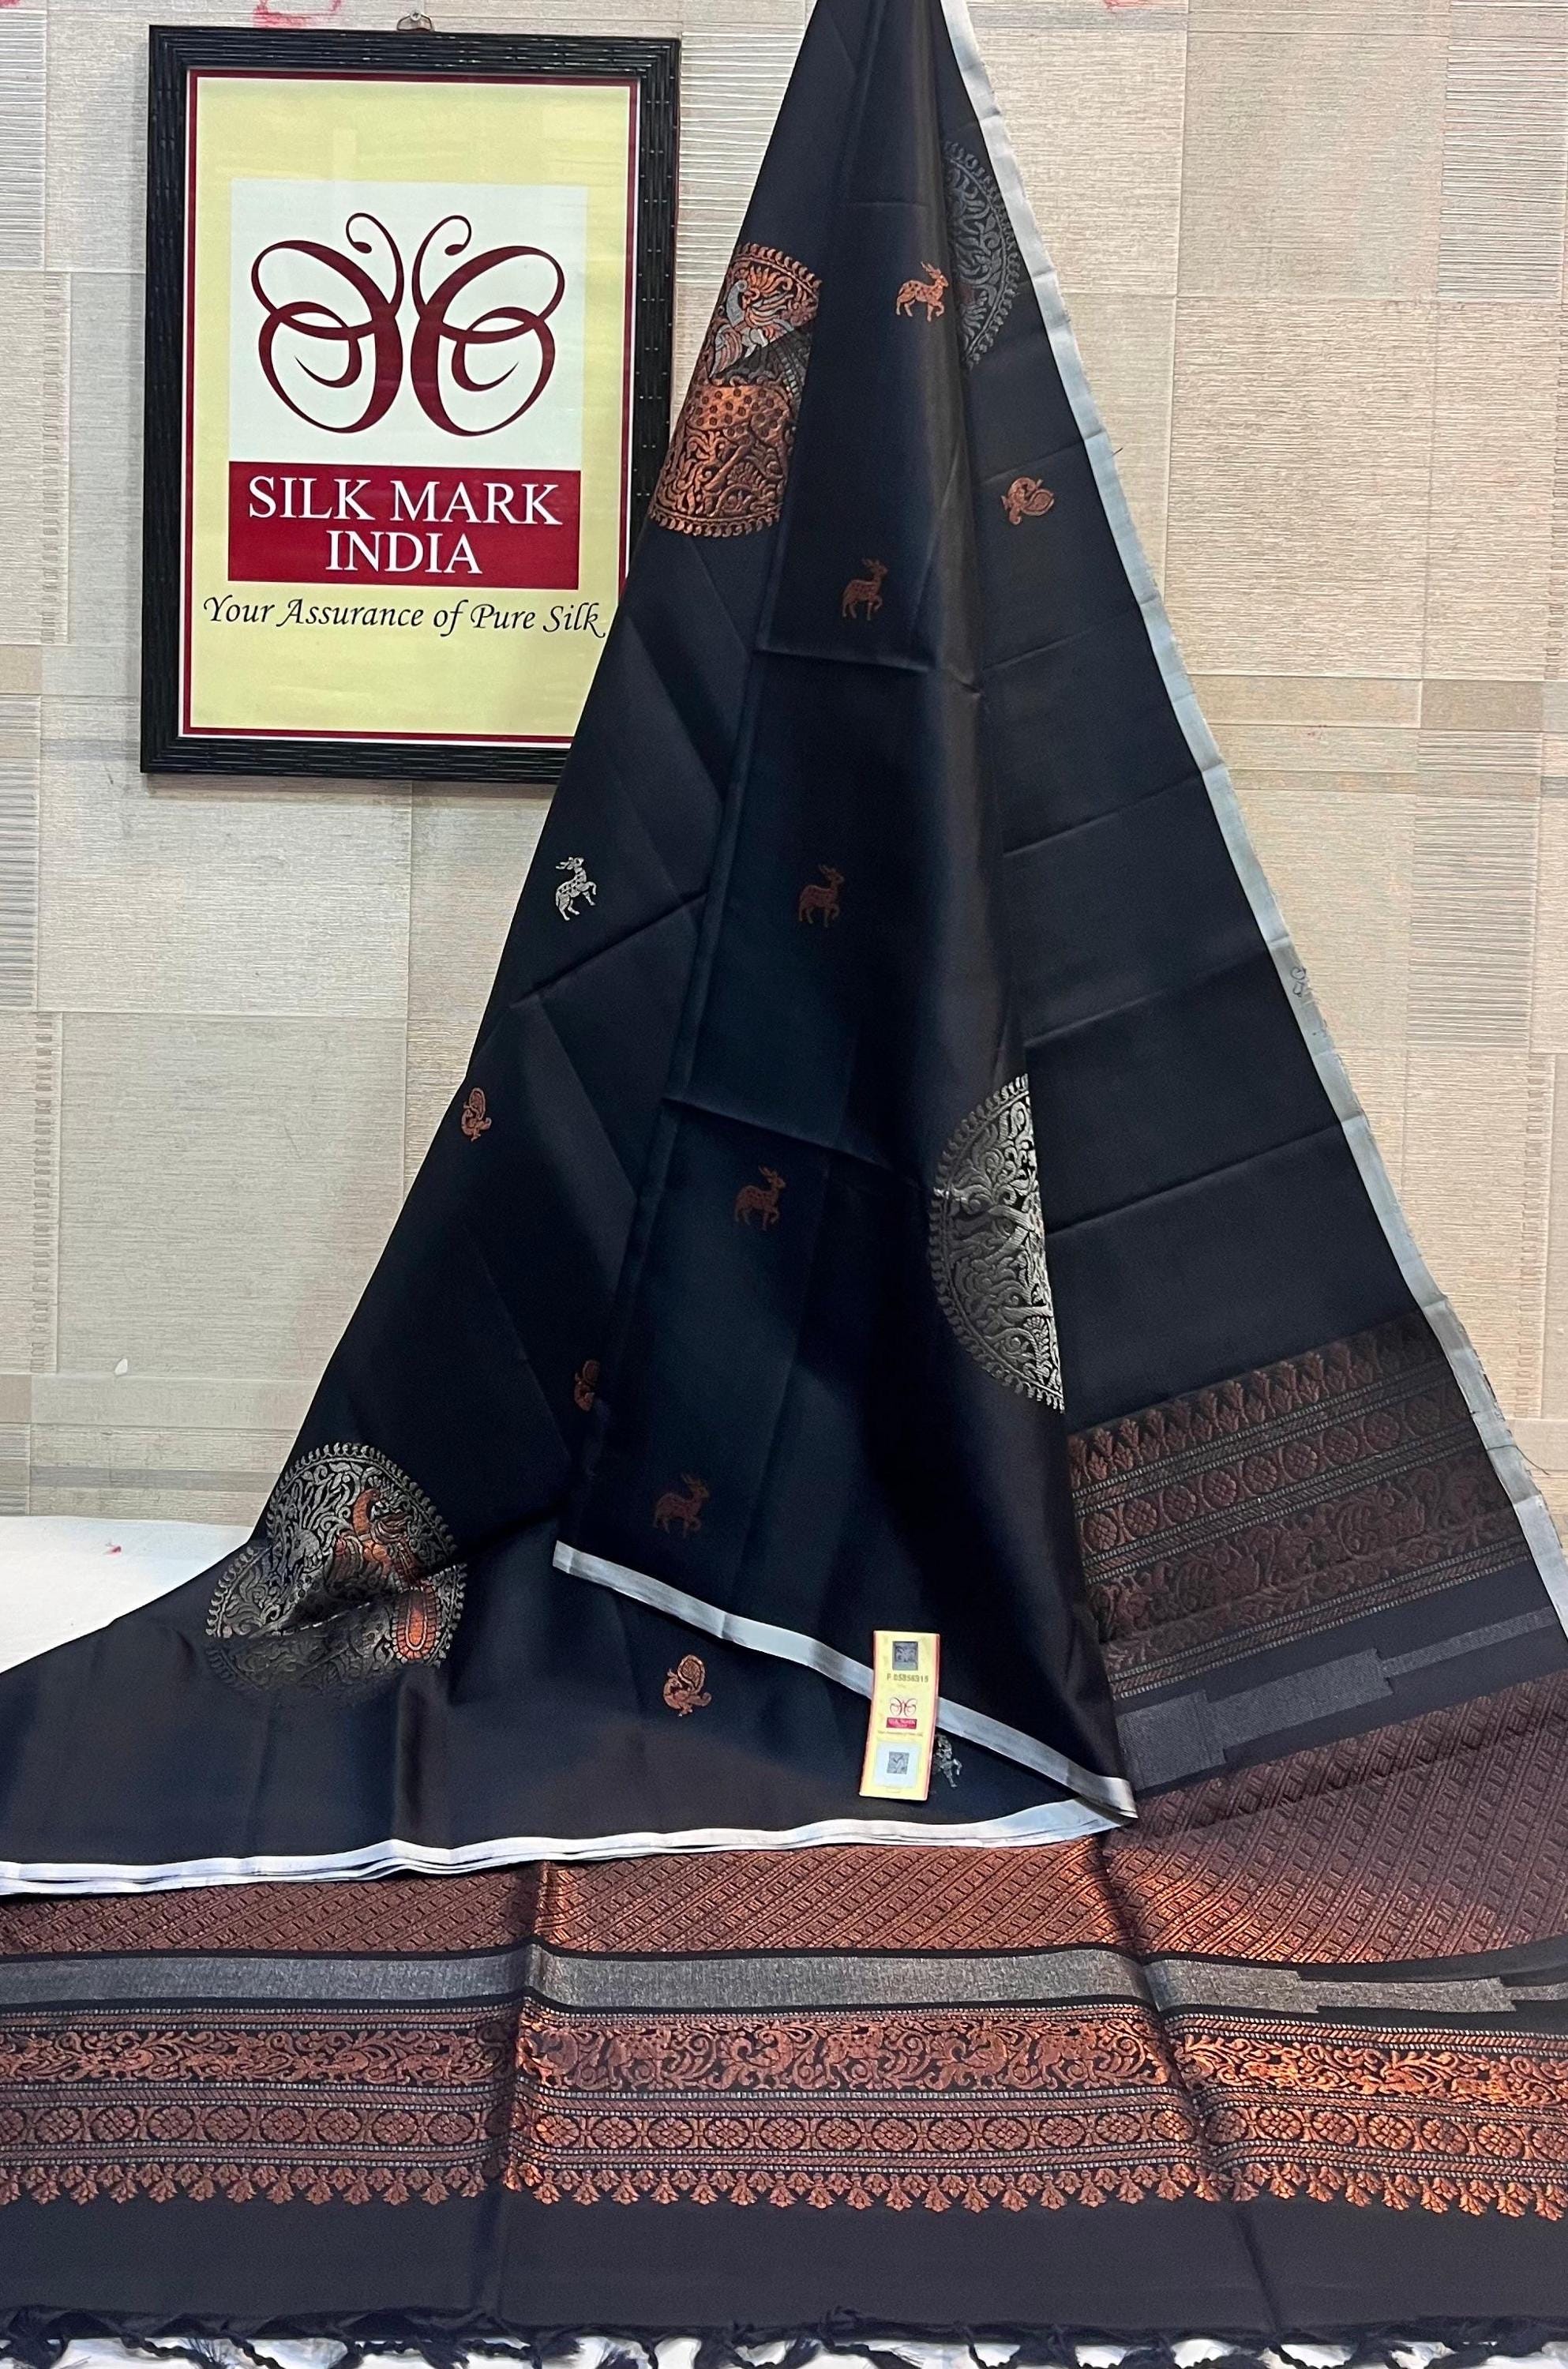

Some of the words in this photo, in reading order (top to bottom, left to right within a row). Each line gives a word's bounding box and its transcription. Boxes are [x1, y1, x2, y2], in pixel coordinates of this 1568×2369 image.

[249, 476, 375, 520] SILK
[390, 481, 563, 525] MARK
[326, 530, 483, 574] INDIA
[203, 594, 276, 625] Your
[276, 598, 424, 627] Assurance
[433, 599, 469, 637] of
[470, 603, 536, 630] Pure
[543, 602, 606, 638] Silk
